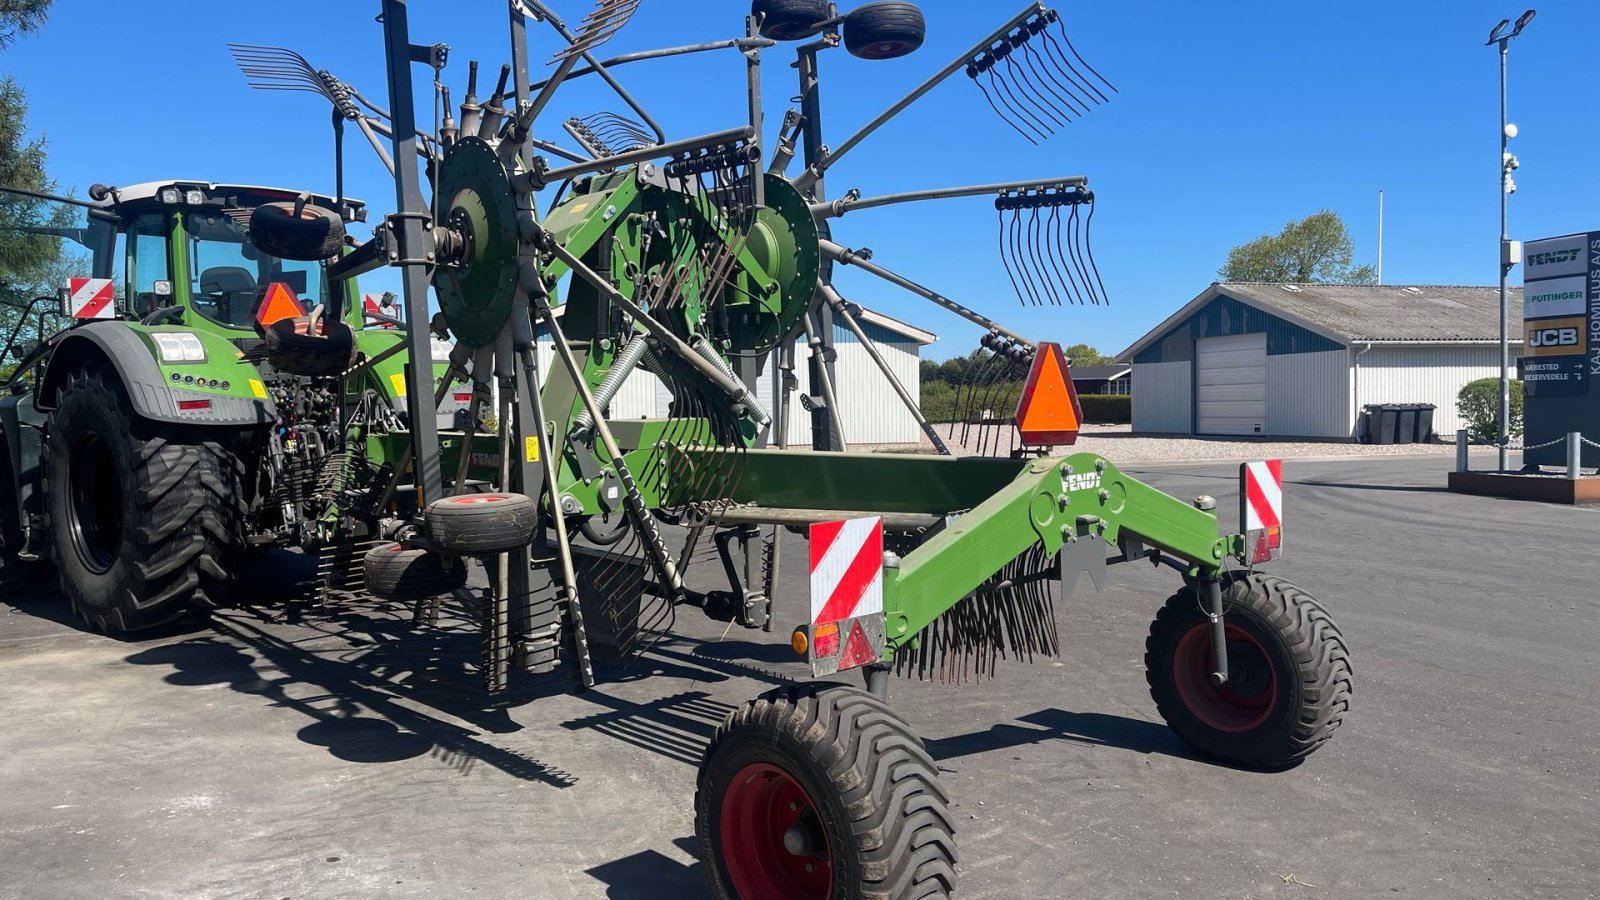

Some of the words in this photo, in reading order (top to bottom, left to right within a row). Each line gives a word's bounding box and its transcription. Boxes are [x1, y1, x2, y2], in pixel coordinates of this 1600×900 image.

[1527, 248, 1581, 266] FENDT
[1590, 239, 1600, 263] A/S
[1590, 269, 1600, 342] HOMILIUS
[1530, 328, 1577, 346] JCB
[1590, 346, 1600, 374] KAJ
[1061, 470, 1104, 493] FENDT
